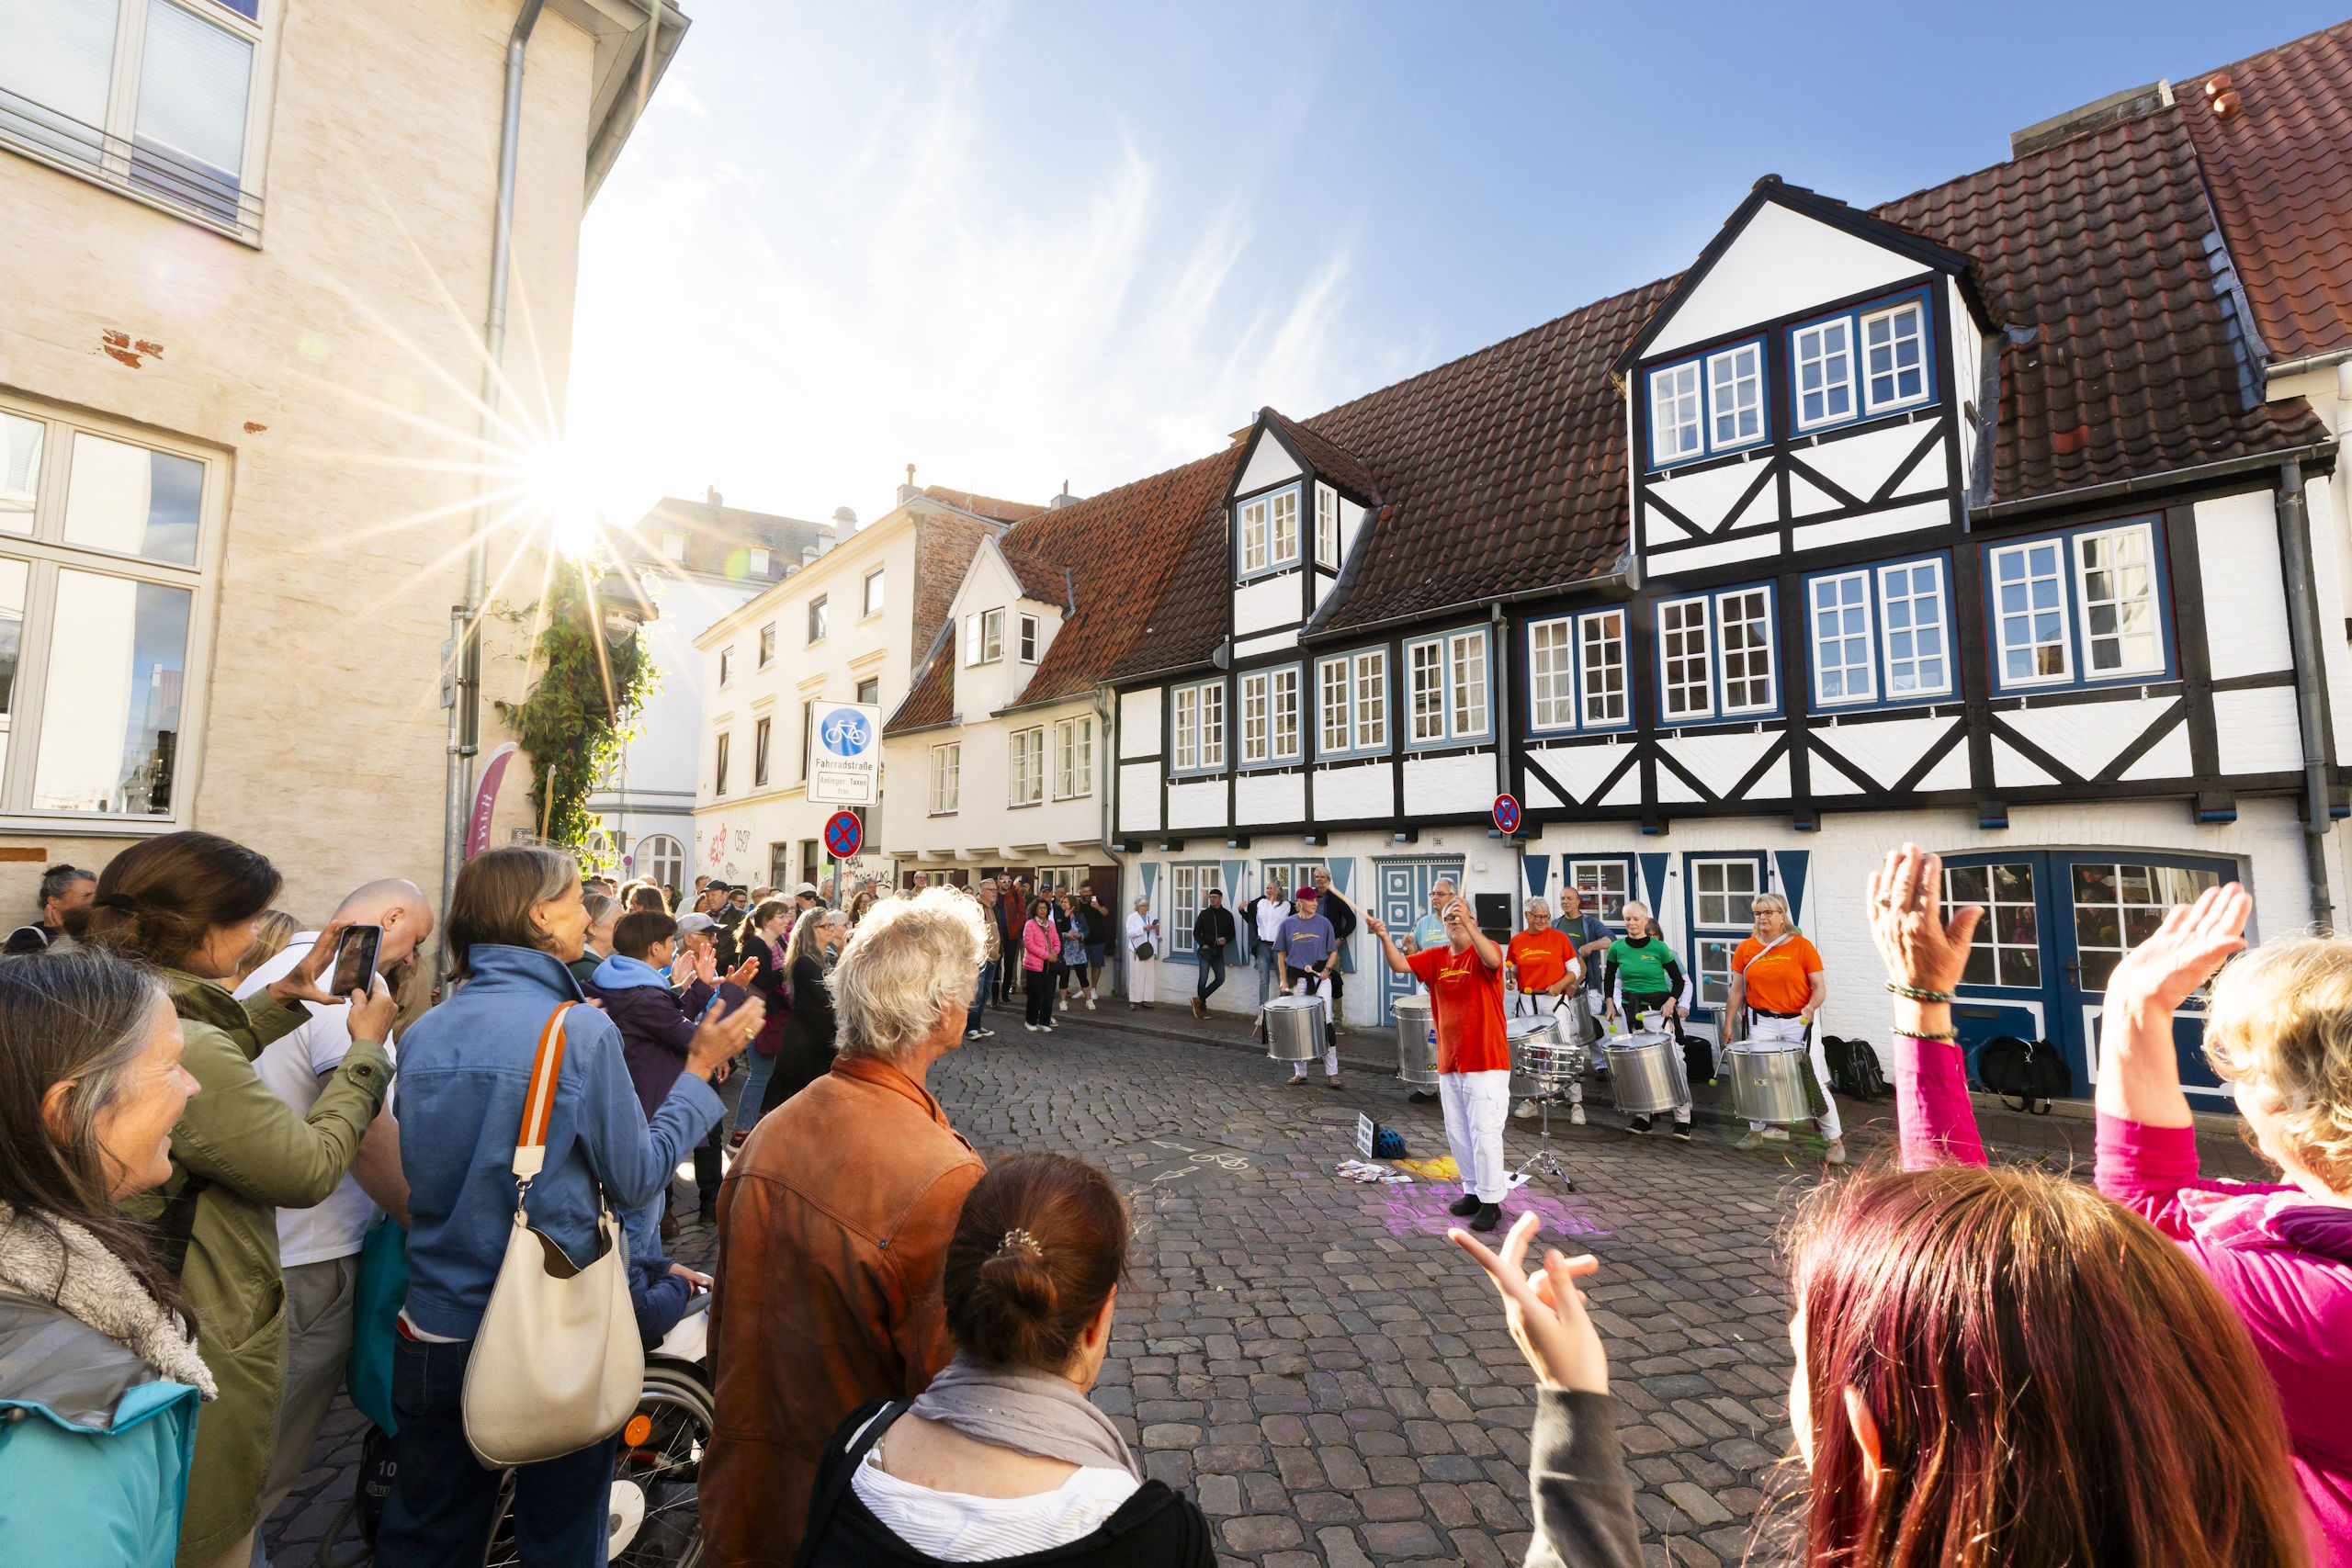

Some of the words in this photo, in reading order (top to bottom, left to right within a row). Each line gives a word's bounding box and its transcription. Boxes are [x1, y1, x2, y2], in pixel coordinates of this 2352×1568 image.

[816, 758, 873, 771] Fahrradstraße
[850, 778, 867, 786] Taxen
[379, 1460, 398, 1477] 10
